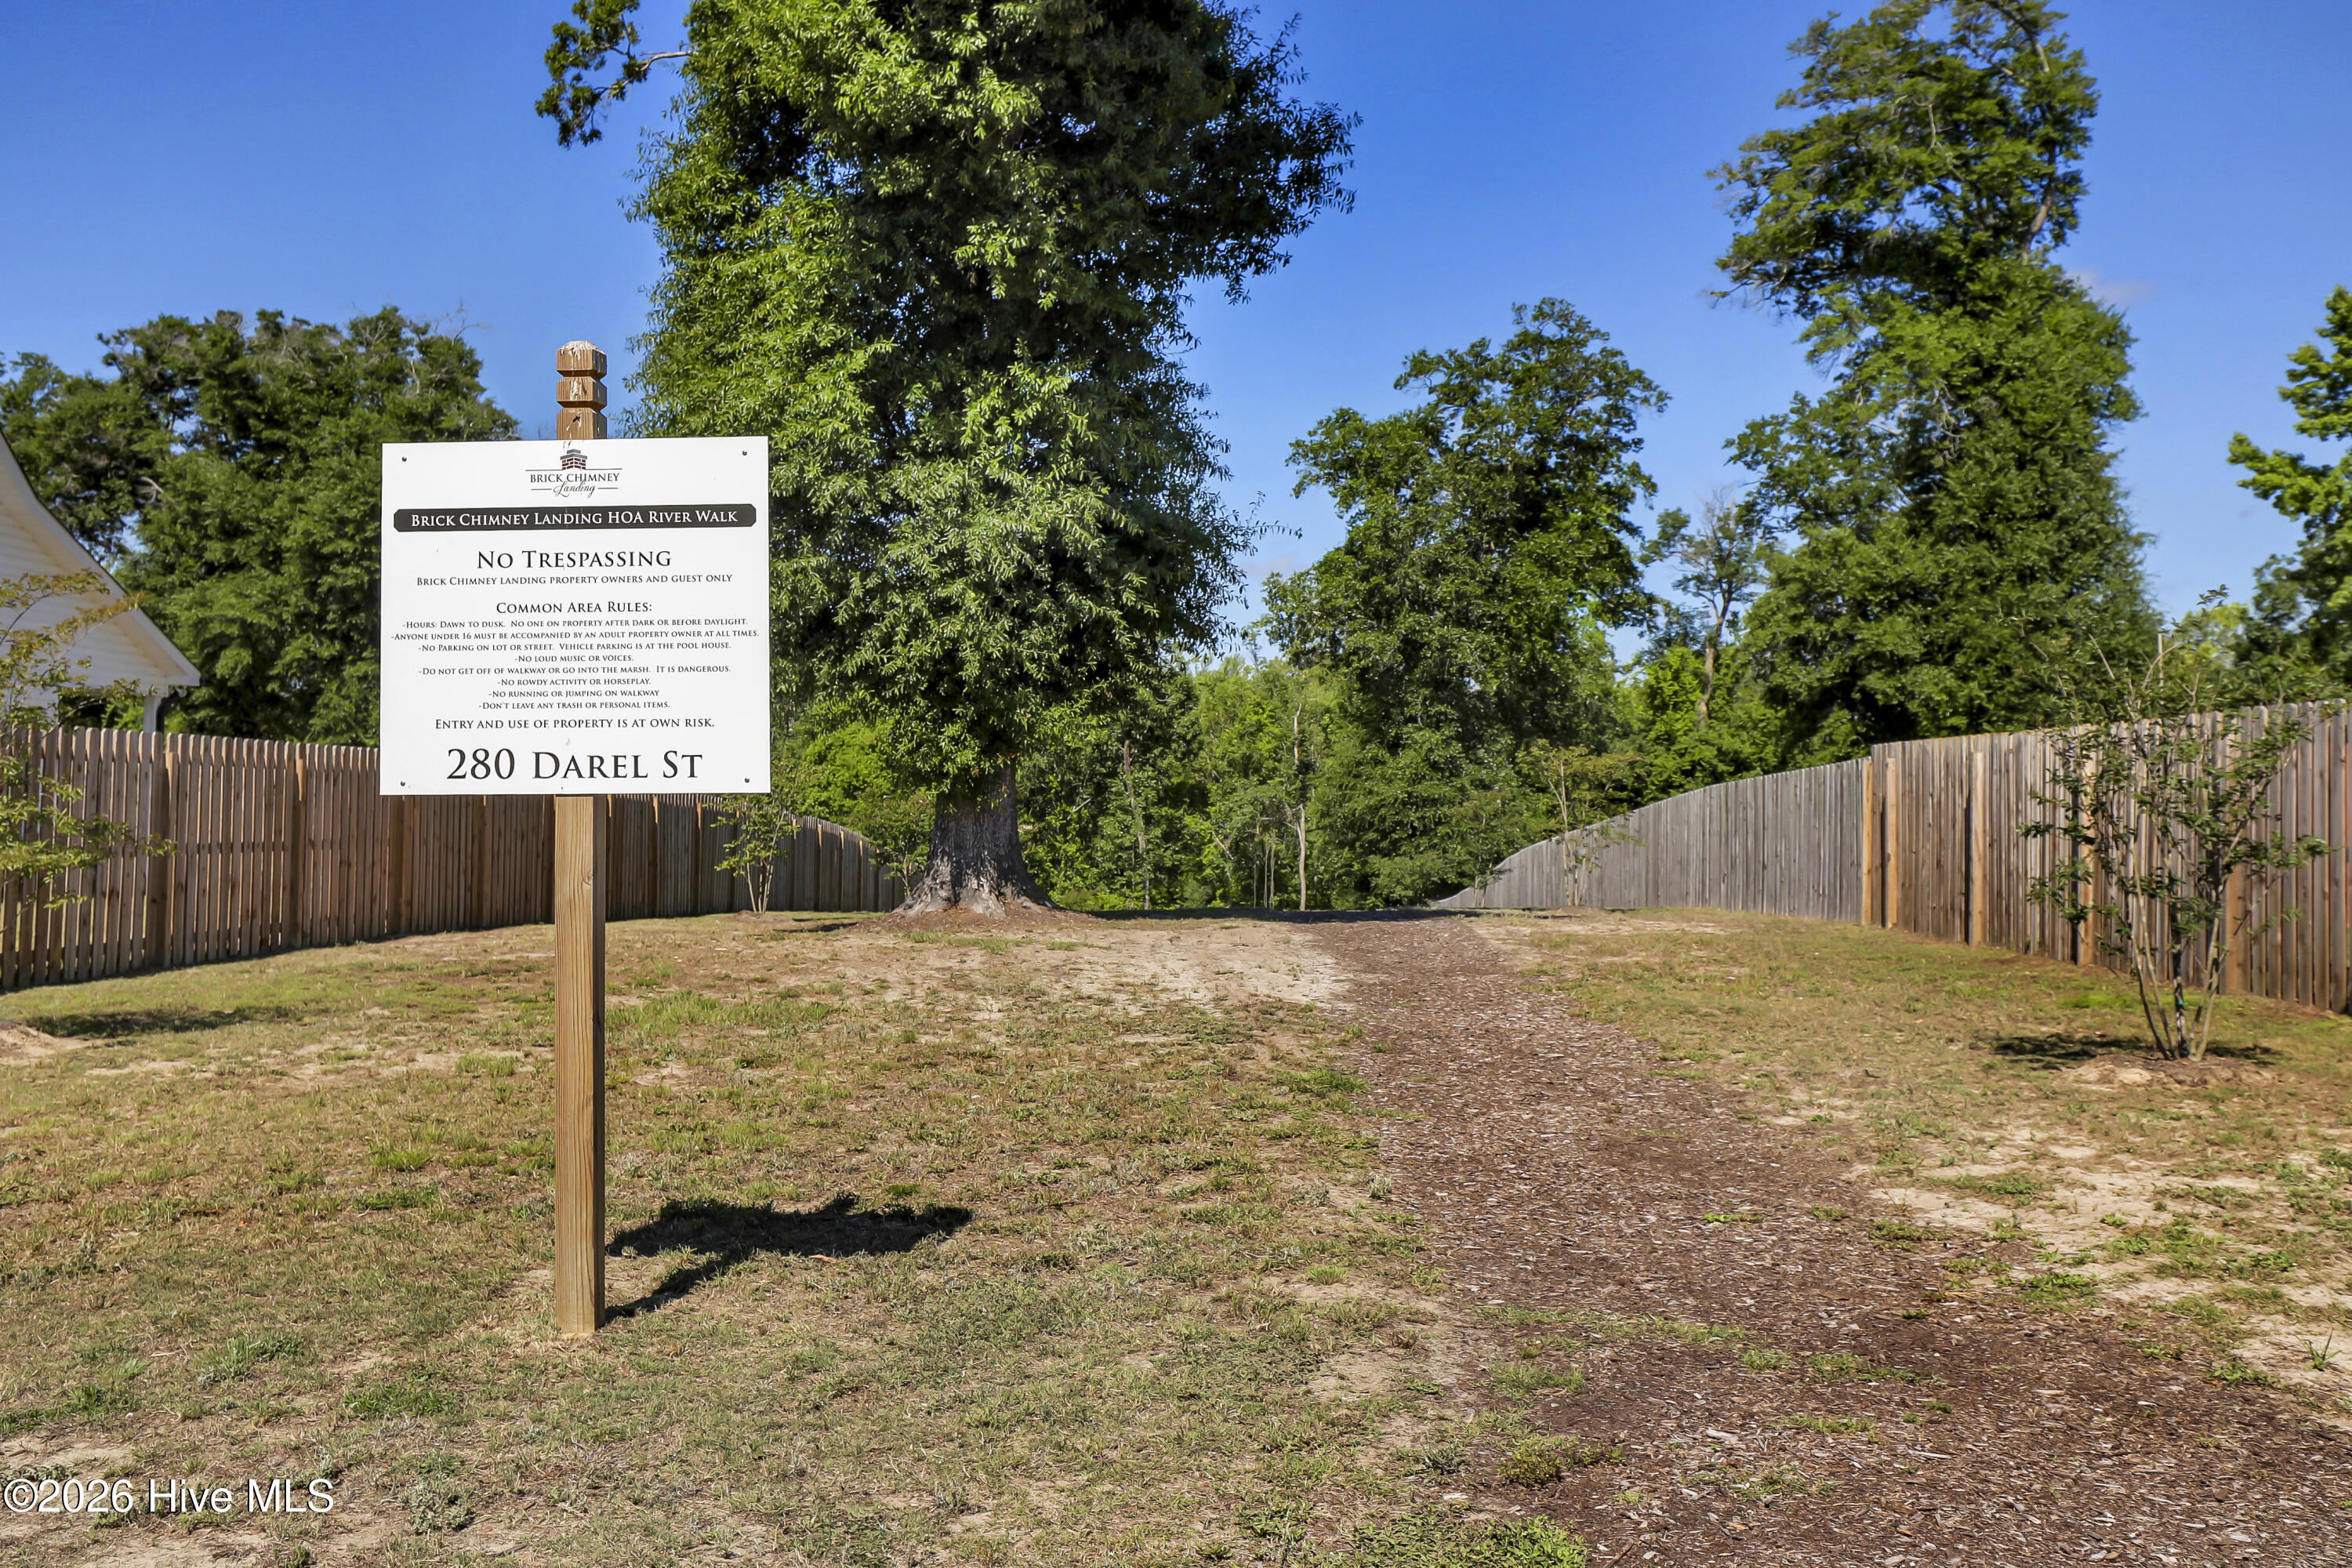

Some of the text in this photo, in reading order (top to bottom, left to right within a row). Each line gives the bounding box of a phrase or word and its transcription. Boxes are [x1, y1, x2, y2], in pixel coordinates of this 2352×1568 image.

[530, 472, 620, 483] BRICK CHIMNEY
[553, 480, 596, 499] Landing
[412, 510, 738, 527] BRICK CHIMNEY LANDING HOA RIVER WALK
[477, 550, 672, 569] NO TRESPASSING
[417, 577, 447, 586] BRICK
[449, 576, 497, 586] CHIMNEY
[500, 576, 546, 585] LANDING
[550, 575, 598, 584] PROPERTY
[645, 575, 668, 583] AND
[706, 574, 732, 583] ONLY
[496, 601, 652, 614] COMMON AREA RULES:
[565, 690, 602, 699] JUMPING
[435, 719, 474, 729] ENTRY
[477, 720, 504, 729] AND
[508, 720, 529, 729] USE
[533, 719, 549, 728] OF
[554, 719, 613, 728] PROPERTY
[617, 719, 628, 728] IS
[631, 718, 647, 728] AT
[650, 718, 680, 728] OWN
[446, 748, 703, 780] 280 DAREL ST
